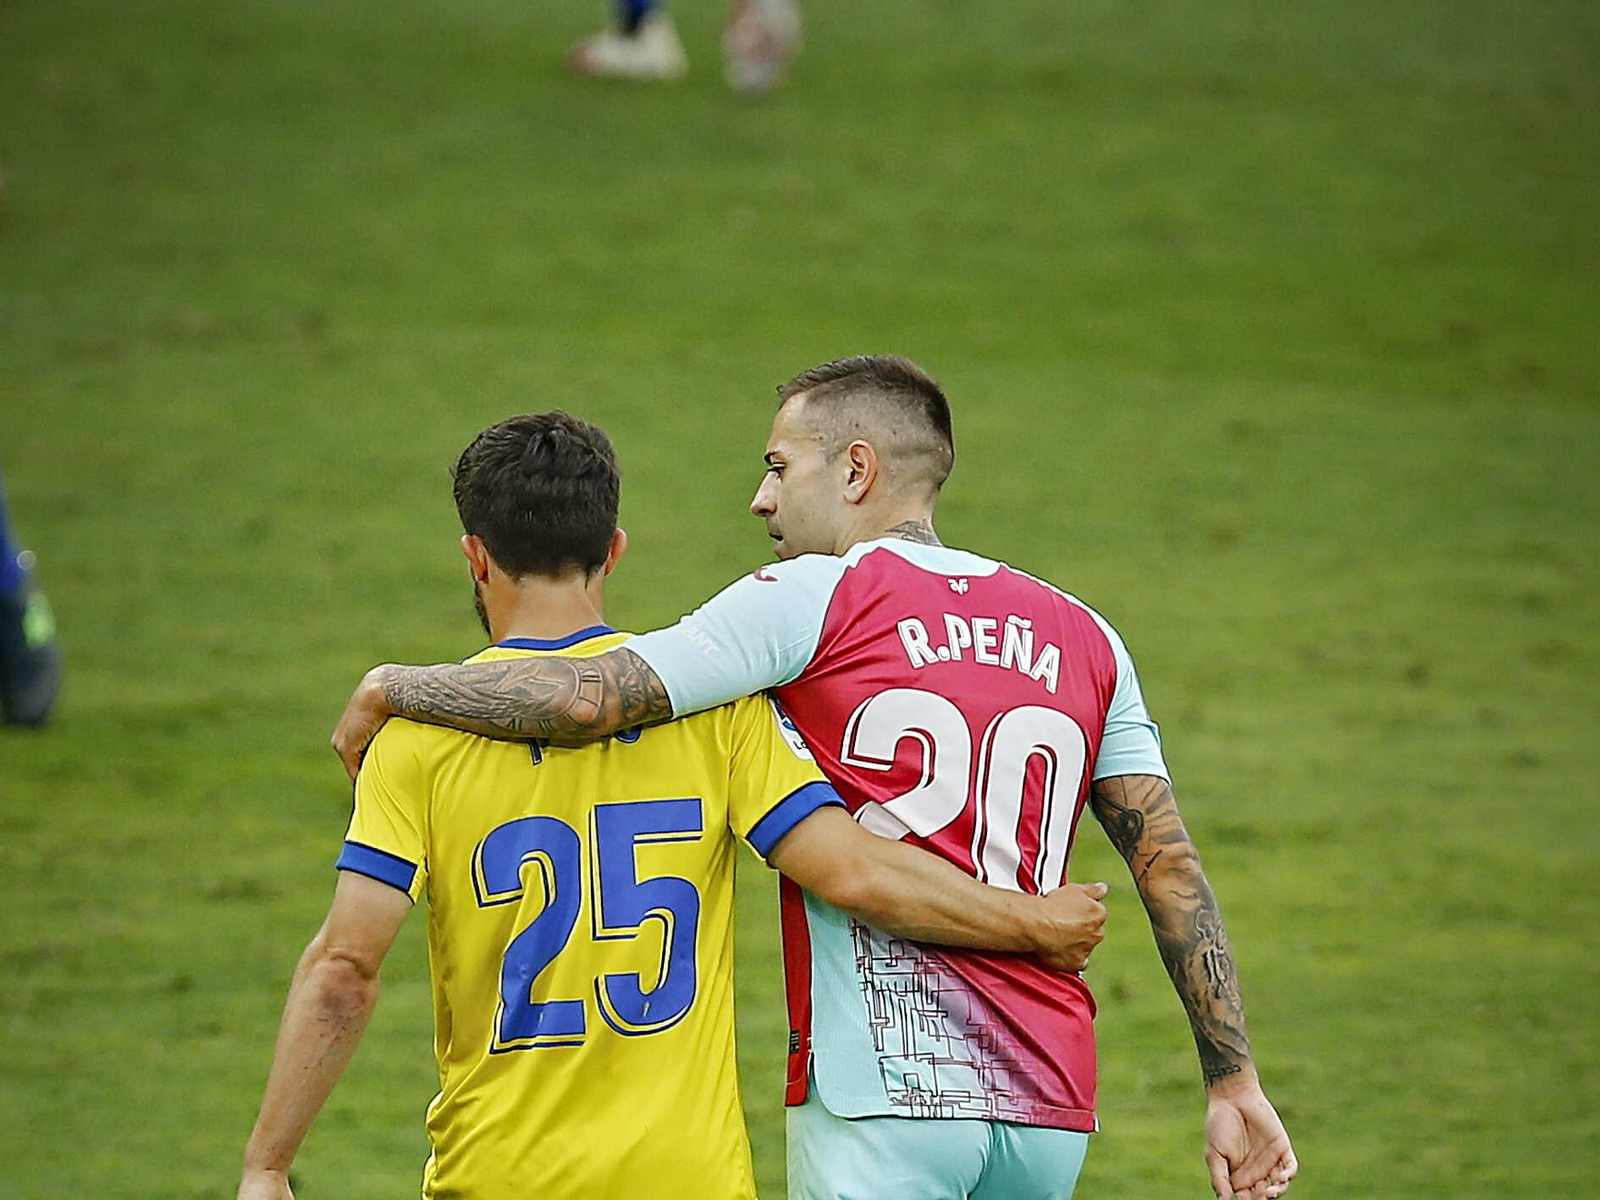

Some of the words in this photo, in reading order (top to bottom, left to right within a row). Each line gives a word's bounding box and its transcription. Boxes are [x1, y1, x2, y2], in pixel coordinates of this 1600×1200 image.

[896, 612, 1062, 695] R.PEÑA
[840, 688, 1088, 897] 20
[472, 798, 703, 1055] 25
